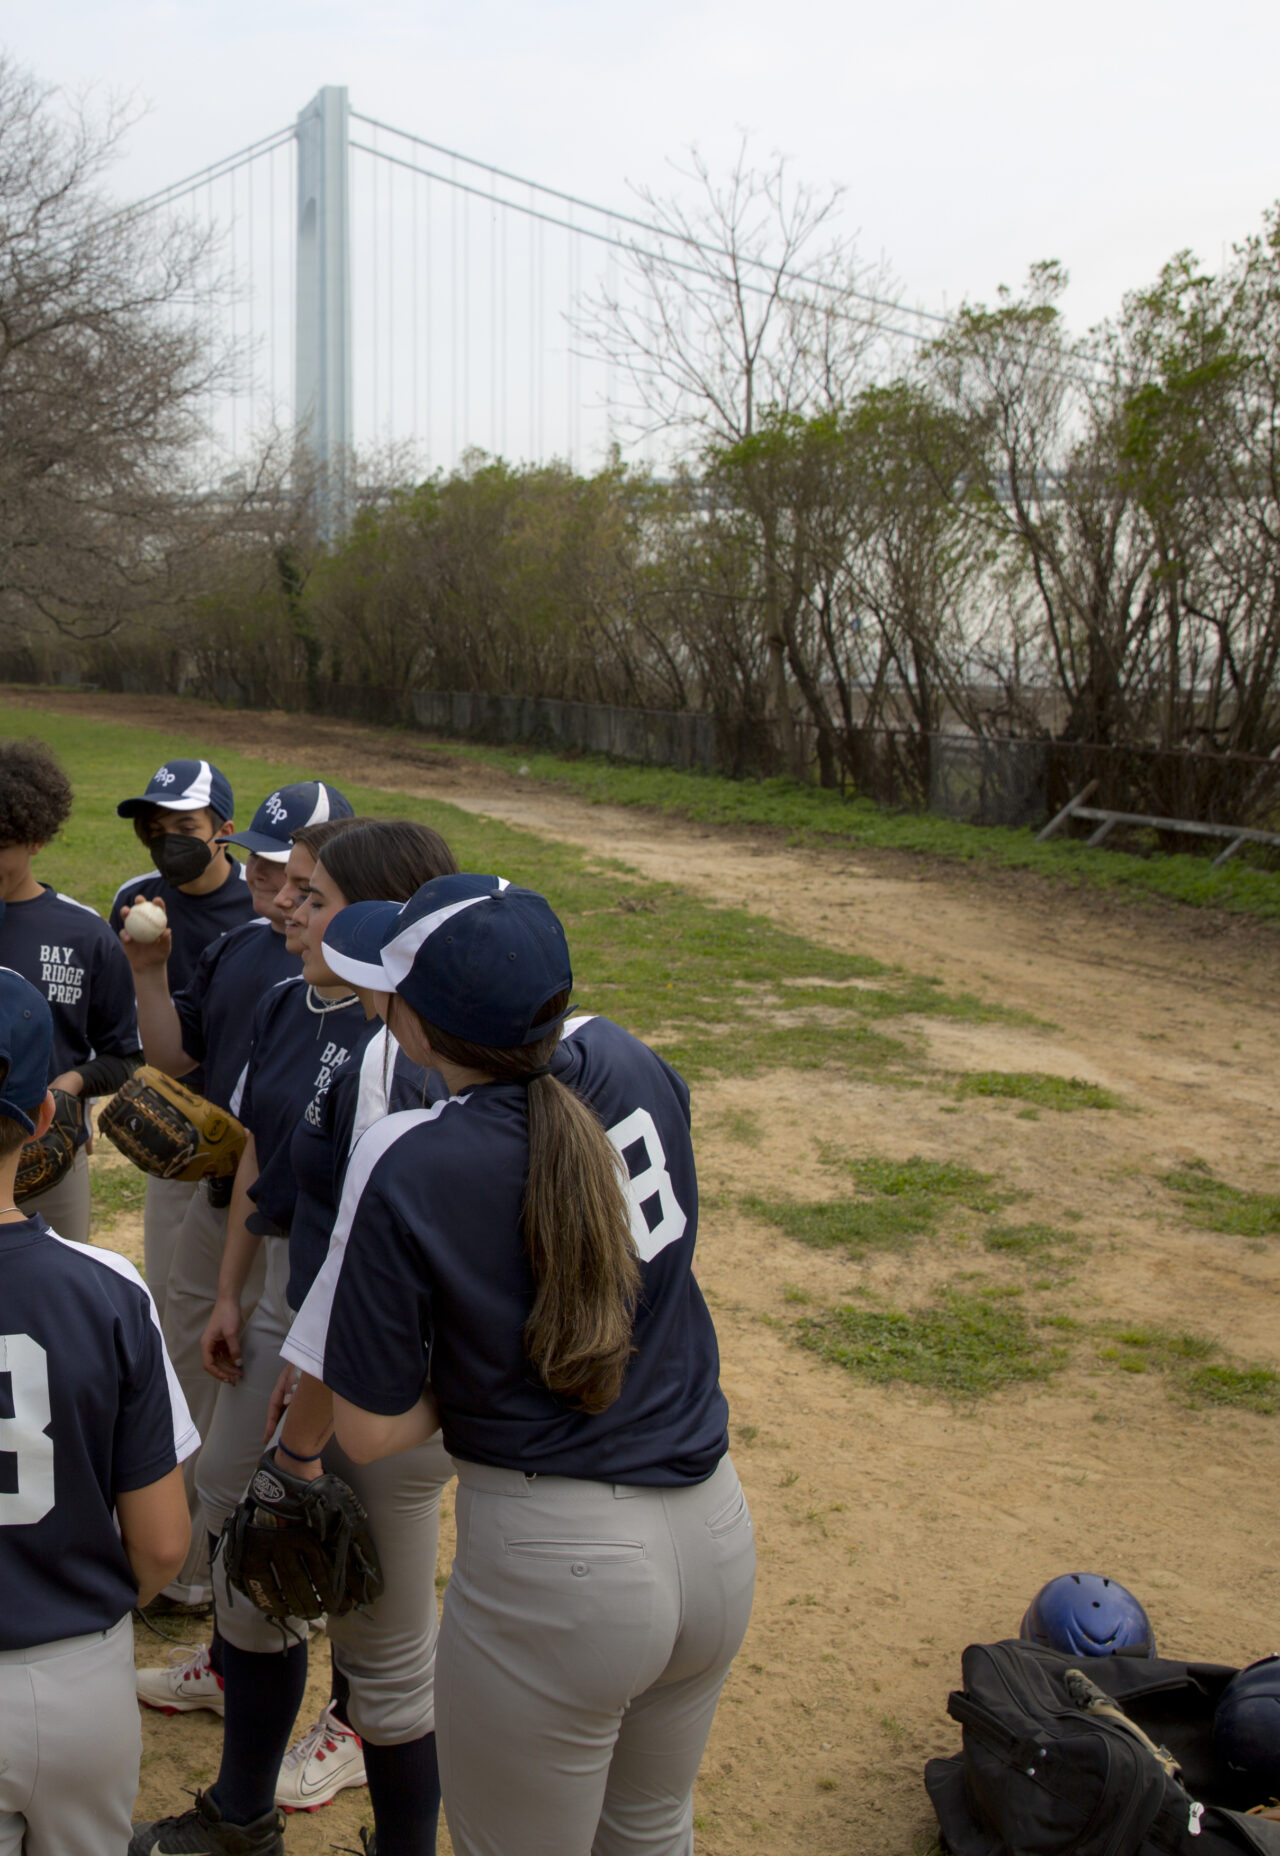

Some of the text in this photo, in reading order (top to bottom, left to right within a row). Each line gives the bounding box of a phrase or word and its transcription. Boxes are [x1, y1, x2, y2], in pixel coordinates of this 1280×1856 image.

[40, 945, 74, 965] BAY
[41, 963, 85, 986] RIDGE
[47, 983, 83, 1005] PREP
